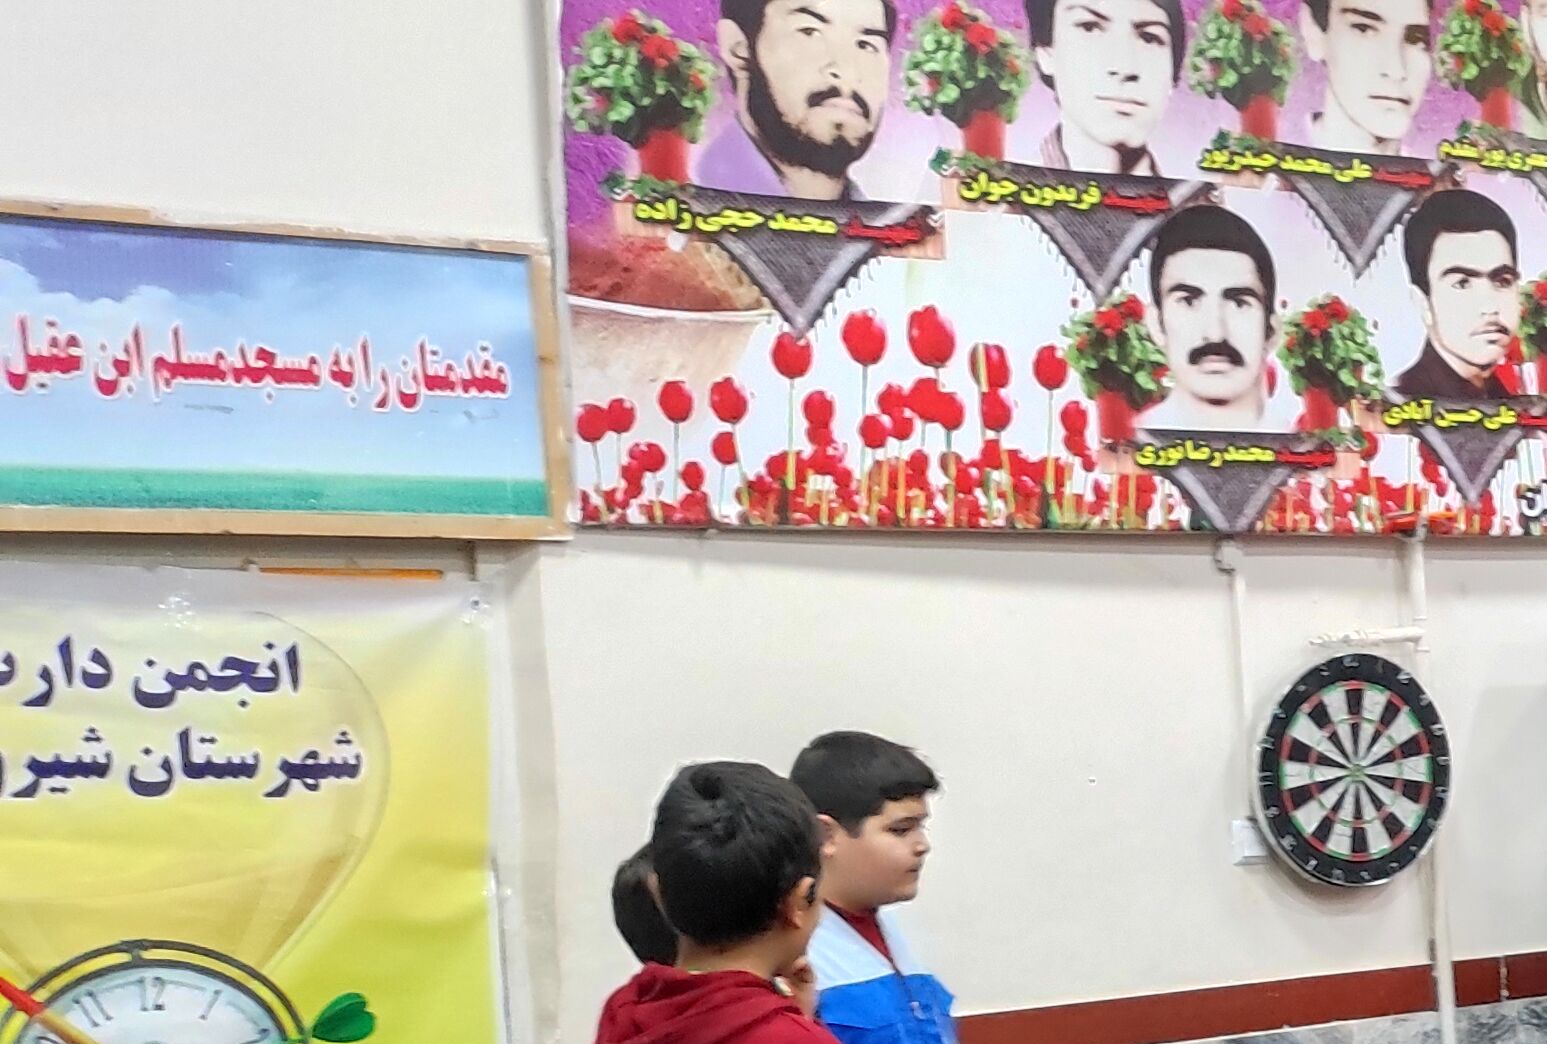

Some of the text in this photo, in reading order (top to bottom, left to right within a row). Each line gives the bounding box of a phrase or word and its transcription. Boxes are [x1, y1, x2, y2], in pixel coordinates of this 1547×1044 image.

[767, 214, 839, 236] محمد
[3, 313, 84, 393] عقیل
[92, 322, 146, 398] ابن
[0, 635, 299, 709] انجمن دار
[128, 727, 361, 798] شهرستان
[70, 989, 114, 1028] 11
[138, 975, 166, 1012] 12
[198, 989, 223, 1021] 1
